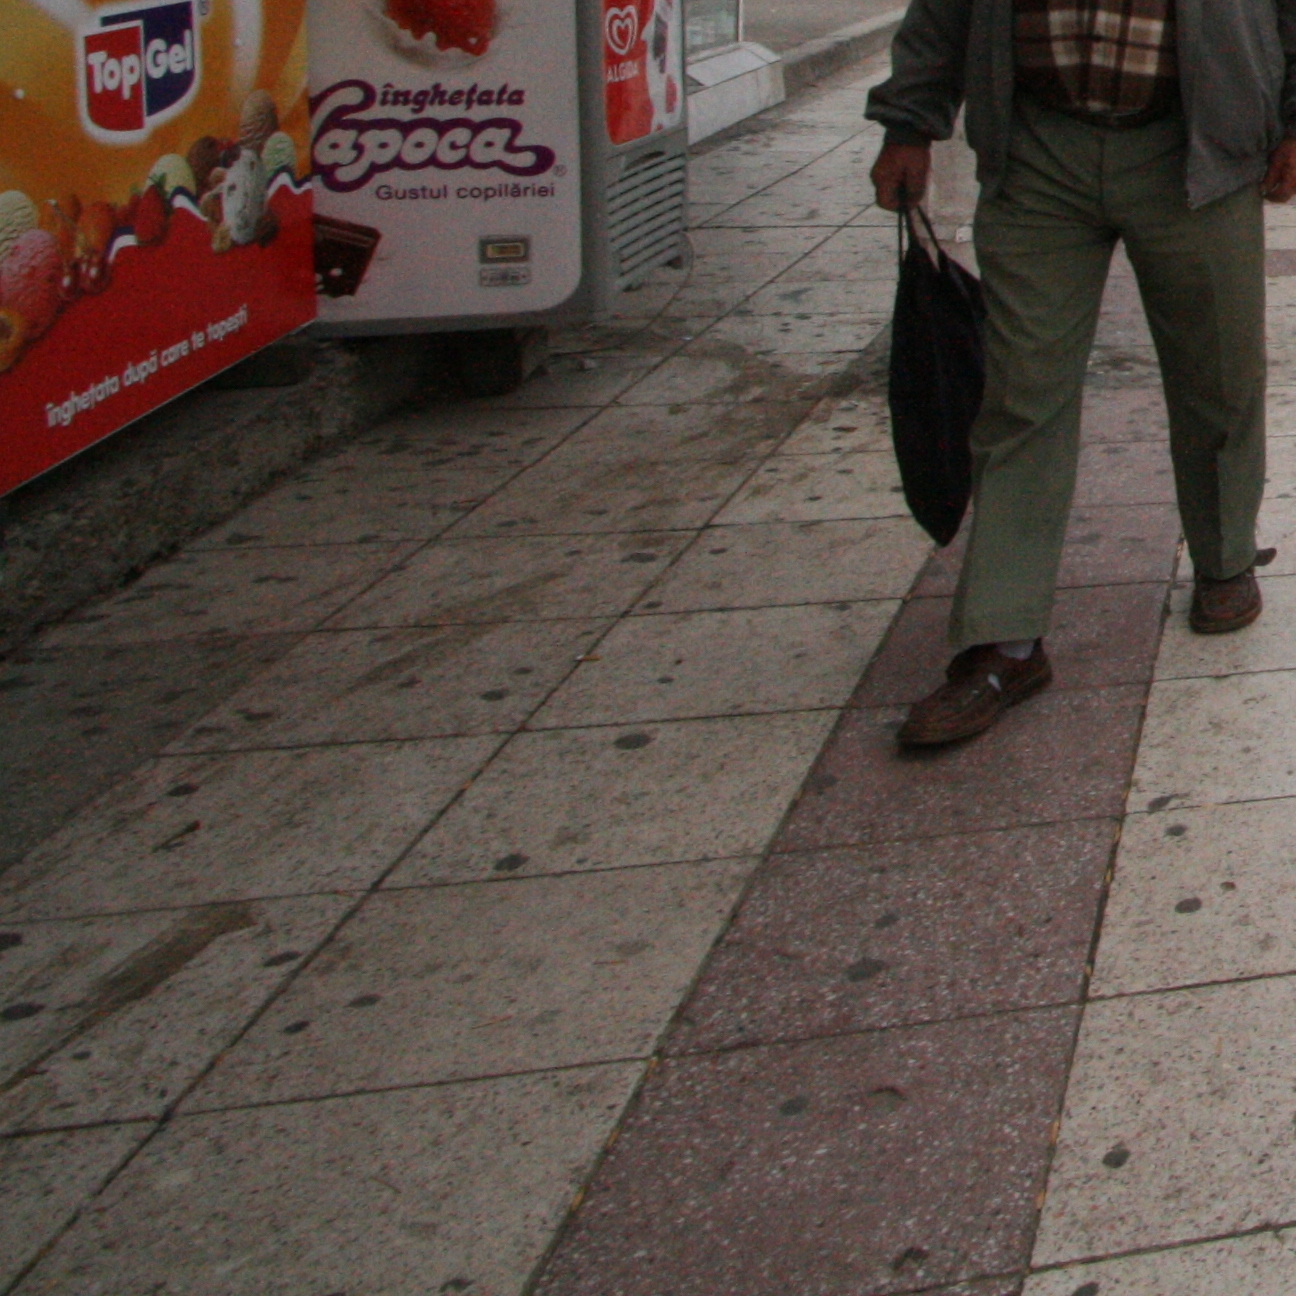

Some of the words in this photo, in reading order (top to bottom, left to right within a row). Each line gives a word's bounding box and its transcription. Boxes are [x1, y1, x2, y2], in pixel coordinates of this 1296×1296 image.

[374, 184, 449, 202] Gustul
[160, 339, 190, 367] care
[191, 330, 206, 351] te
